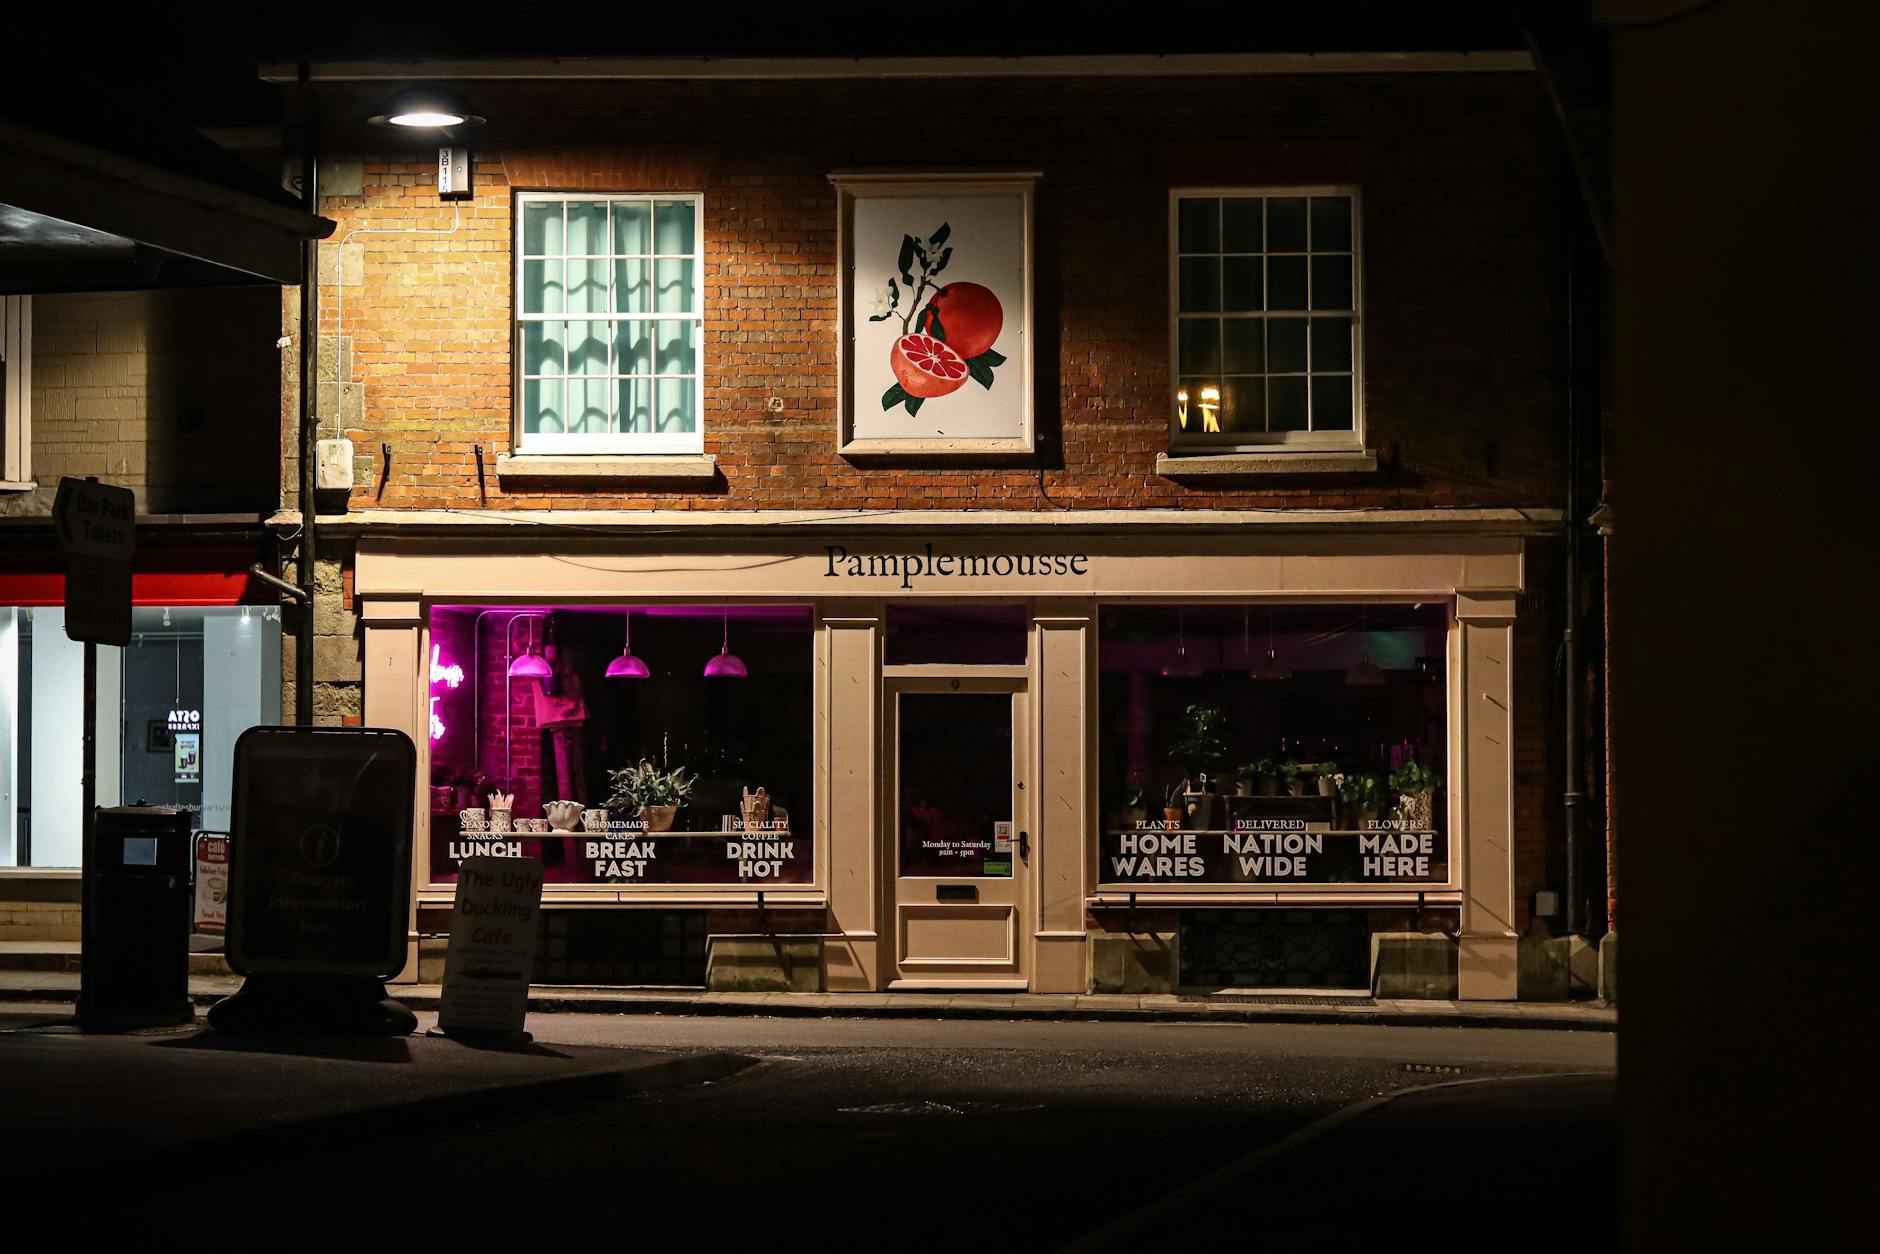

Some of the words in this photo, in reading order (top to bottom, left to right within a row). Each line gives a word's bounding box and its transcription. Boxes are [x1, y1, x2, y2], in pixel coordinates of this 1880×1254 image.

[824, 543, 1089, 589] Pamplemousse
[592, 820, 649, 829] HOMEMADE
[733, 820, 788, 829] SPECIALITY
[1135, 820, 1181, 830] PLANTS
[1236, 819, 1304, 830] DELIVERED
[1368, 819, 1424, 830] FLOWERS
[605, 831, 636, 840] CAKES
[1120, 834, 1197, 854] HOME
[1223, 834, 1323, 854] NATION
[1359, 834, 1433, 854] MADE
[449, 841, 522, 859] LUNCH
[585, 841, 656, 859] BREAK
[727, 842, 795, 859] DRINK
[922, 840, 951, 850] Monday
[961, 840, 992, 850] Saturday
[594, 860, 648, 877] FAST
[738, 860, 783, 877] HOT
[1111, 857, 1205, 877] WARES
[1238, 857, 1307, 877] WIDE
[1363, 857, 1430, 877] HERE
